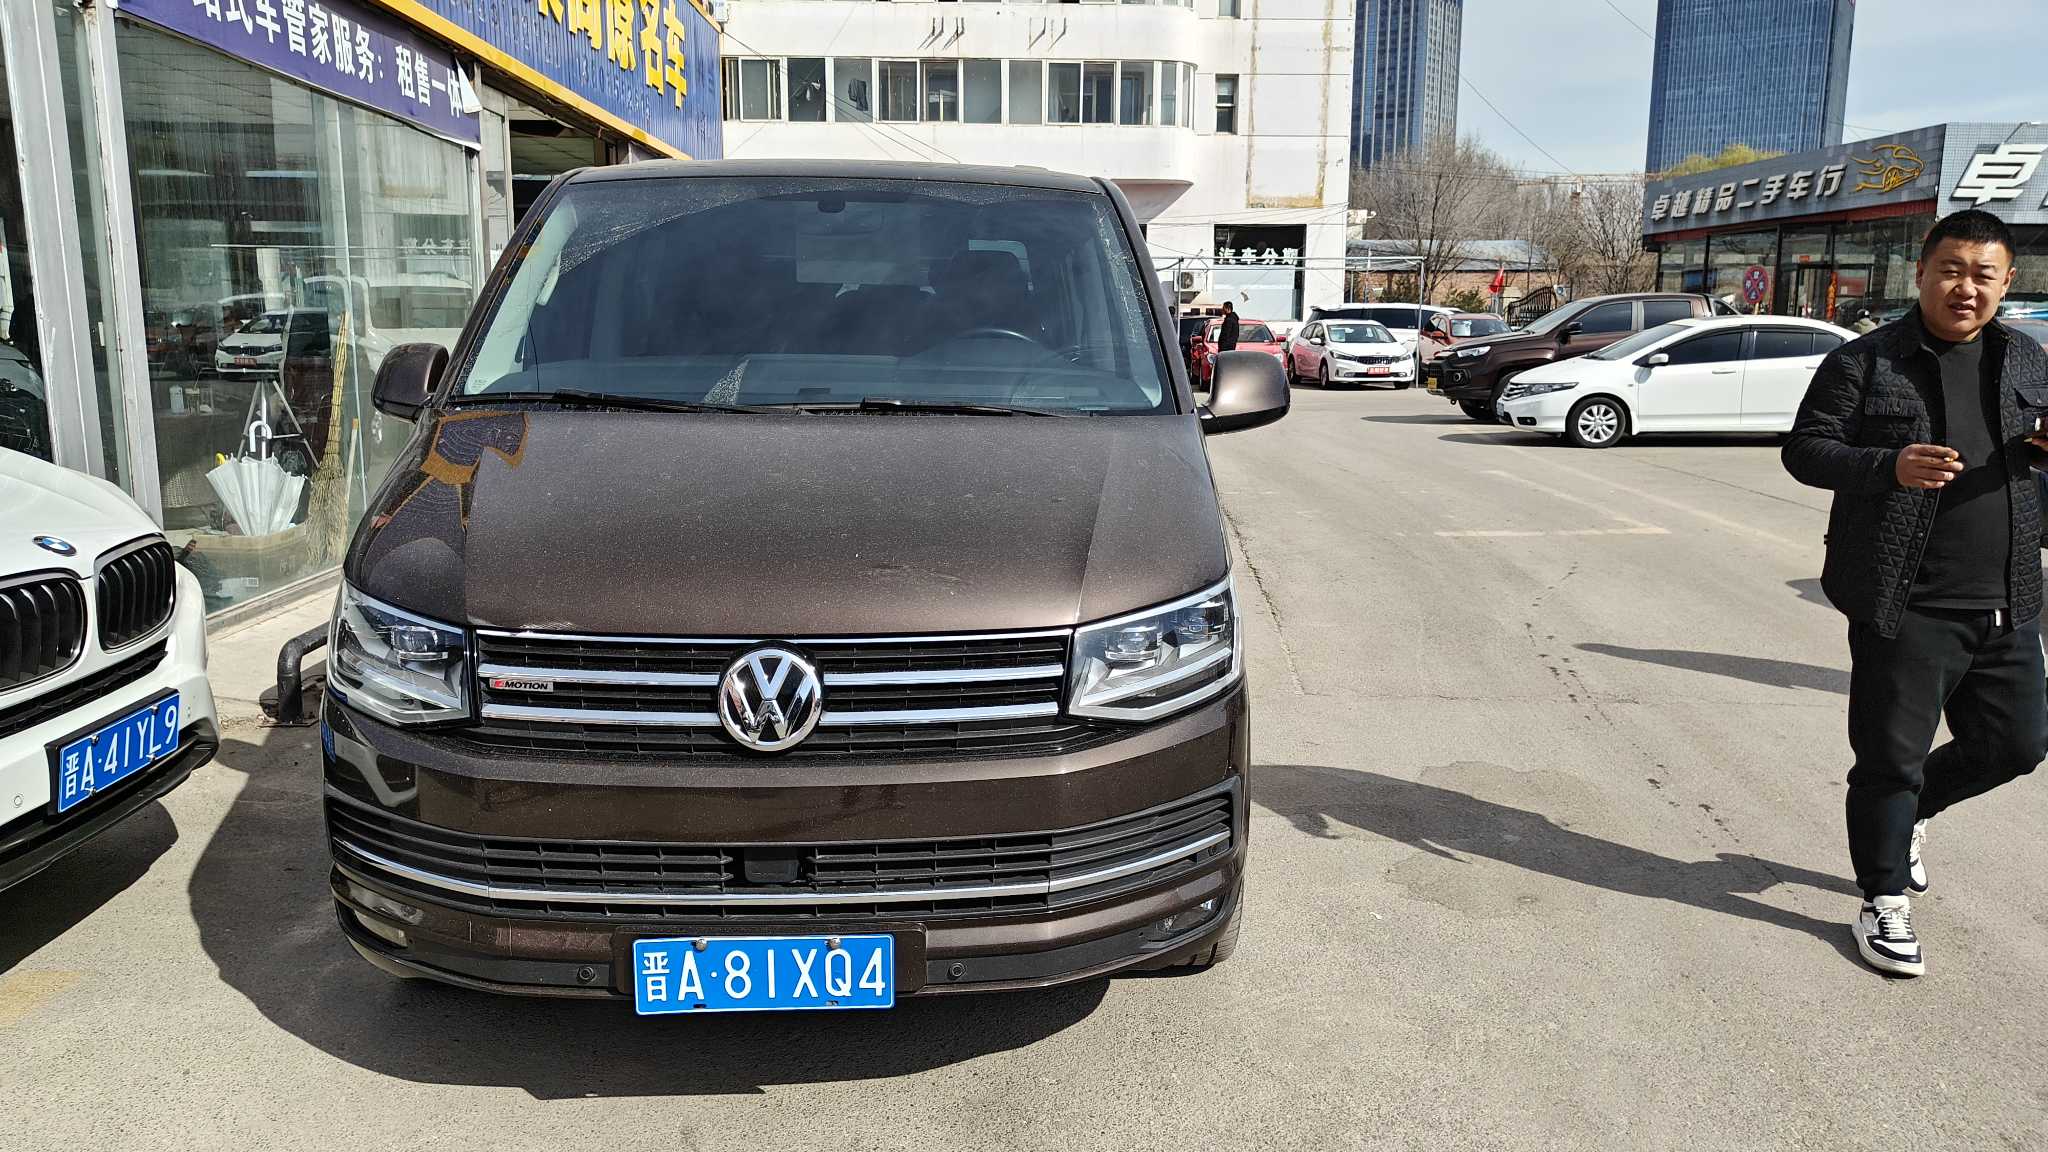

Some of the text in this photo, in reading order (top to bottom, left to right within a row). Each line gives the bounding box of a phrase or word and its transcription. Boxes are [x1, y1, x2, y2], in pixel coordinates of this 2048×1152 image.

[1650, 164, 1848, 220] 卓越精品二手车行
[1951, 142, 2048, 207] 卓
[1218, 247, 1299, 265] 汽车分期
